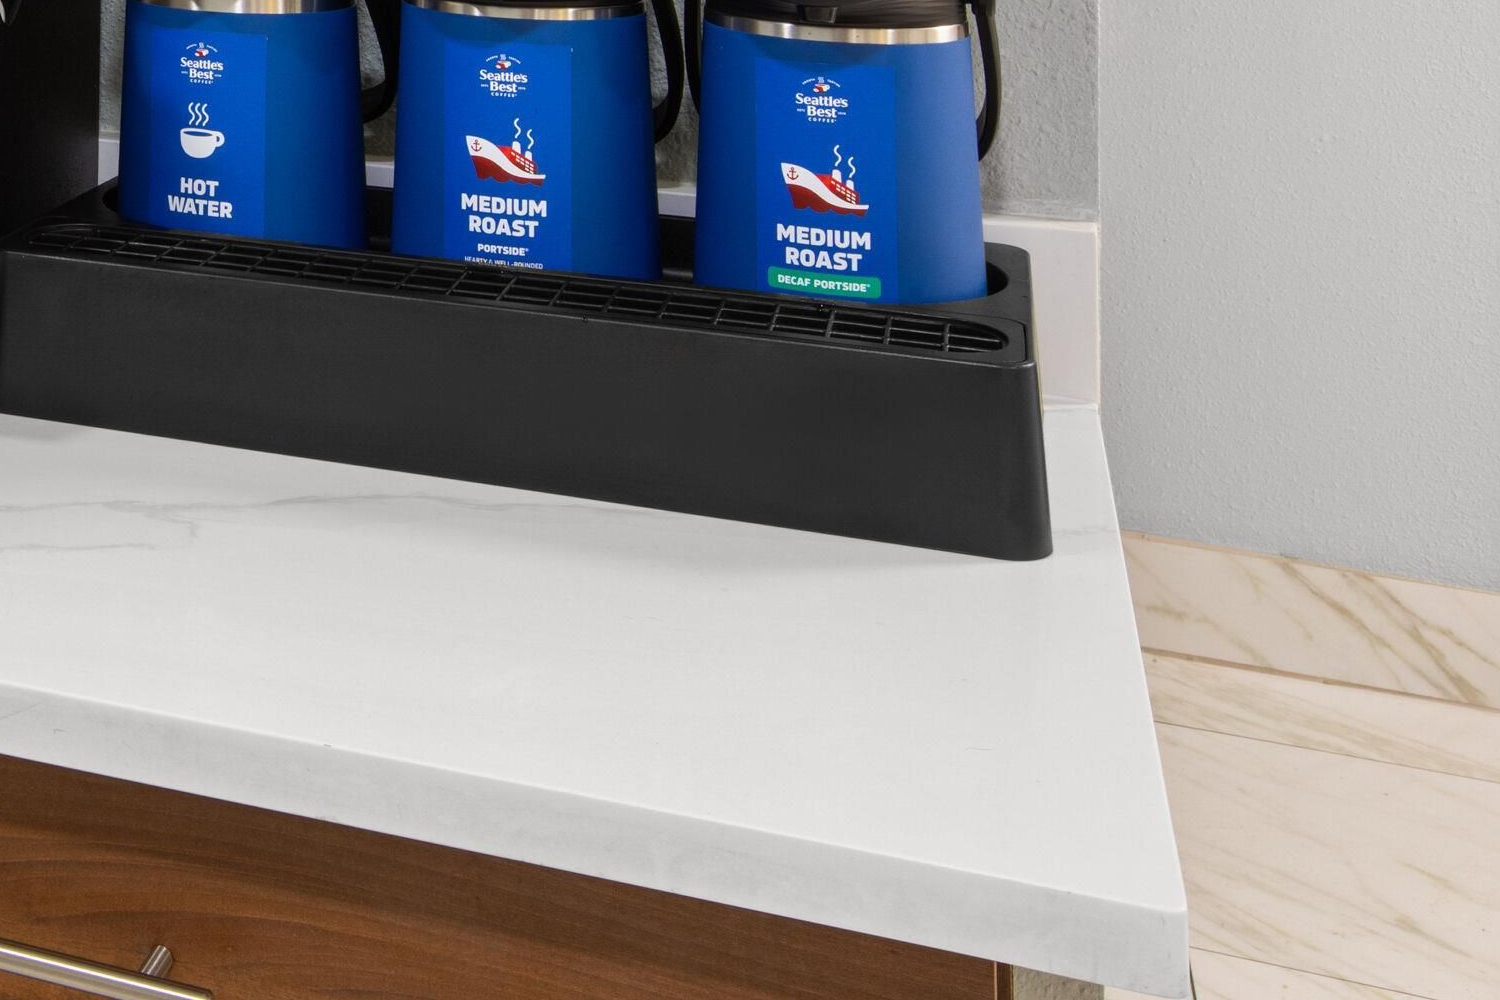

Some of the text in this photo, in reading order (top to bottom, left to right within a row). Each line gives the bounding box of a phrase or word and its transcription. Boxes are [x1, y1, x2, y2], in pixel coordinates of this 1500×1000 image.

[180, 56, 224, 71] Seattle's
[189, 68, 214, 80] Best
[479, 69, 528, 83] Seattle's
[490, 81, 517, 93] Best
[795, 92, 849, 108] Seattle's
[807, 105, 837, 118] Best
[180, 177, 219, 197] HOT
[168, 194, 233, 218] WATER
[461, 193, 547, 217] MEDIUM
[469, 215, 539, 238] ROAST
[776, 223, 871, 250] MEDIUM
[785, 246, 863, 271] ROAST
[777, 274, 811, 287] DECAF
